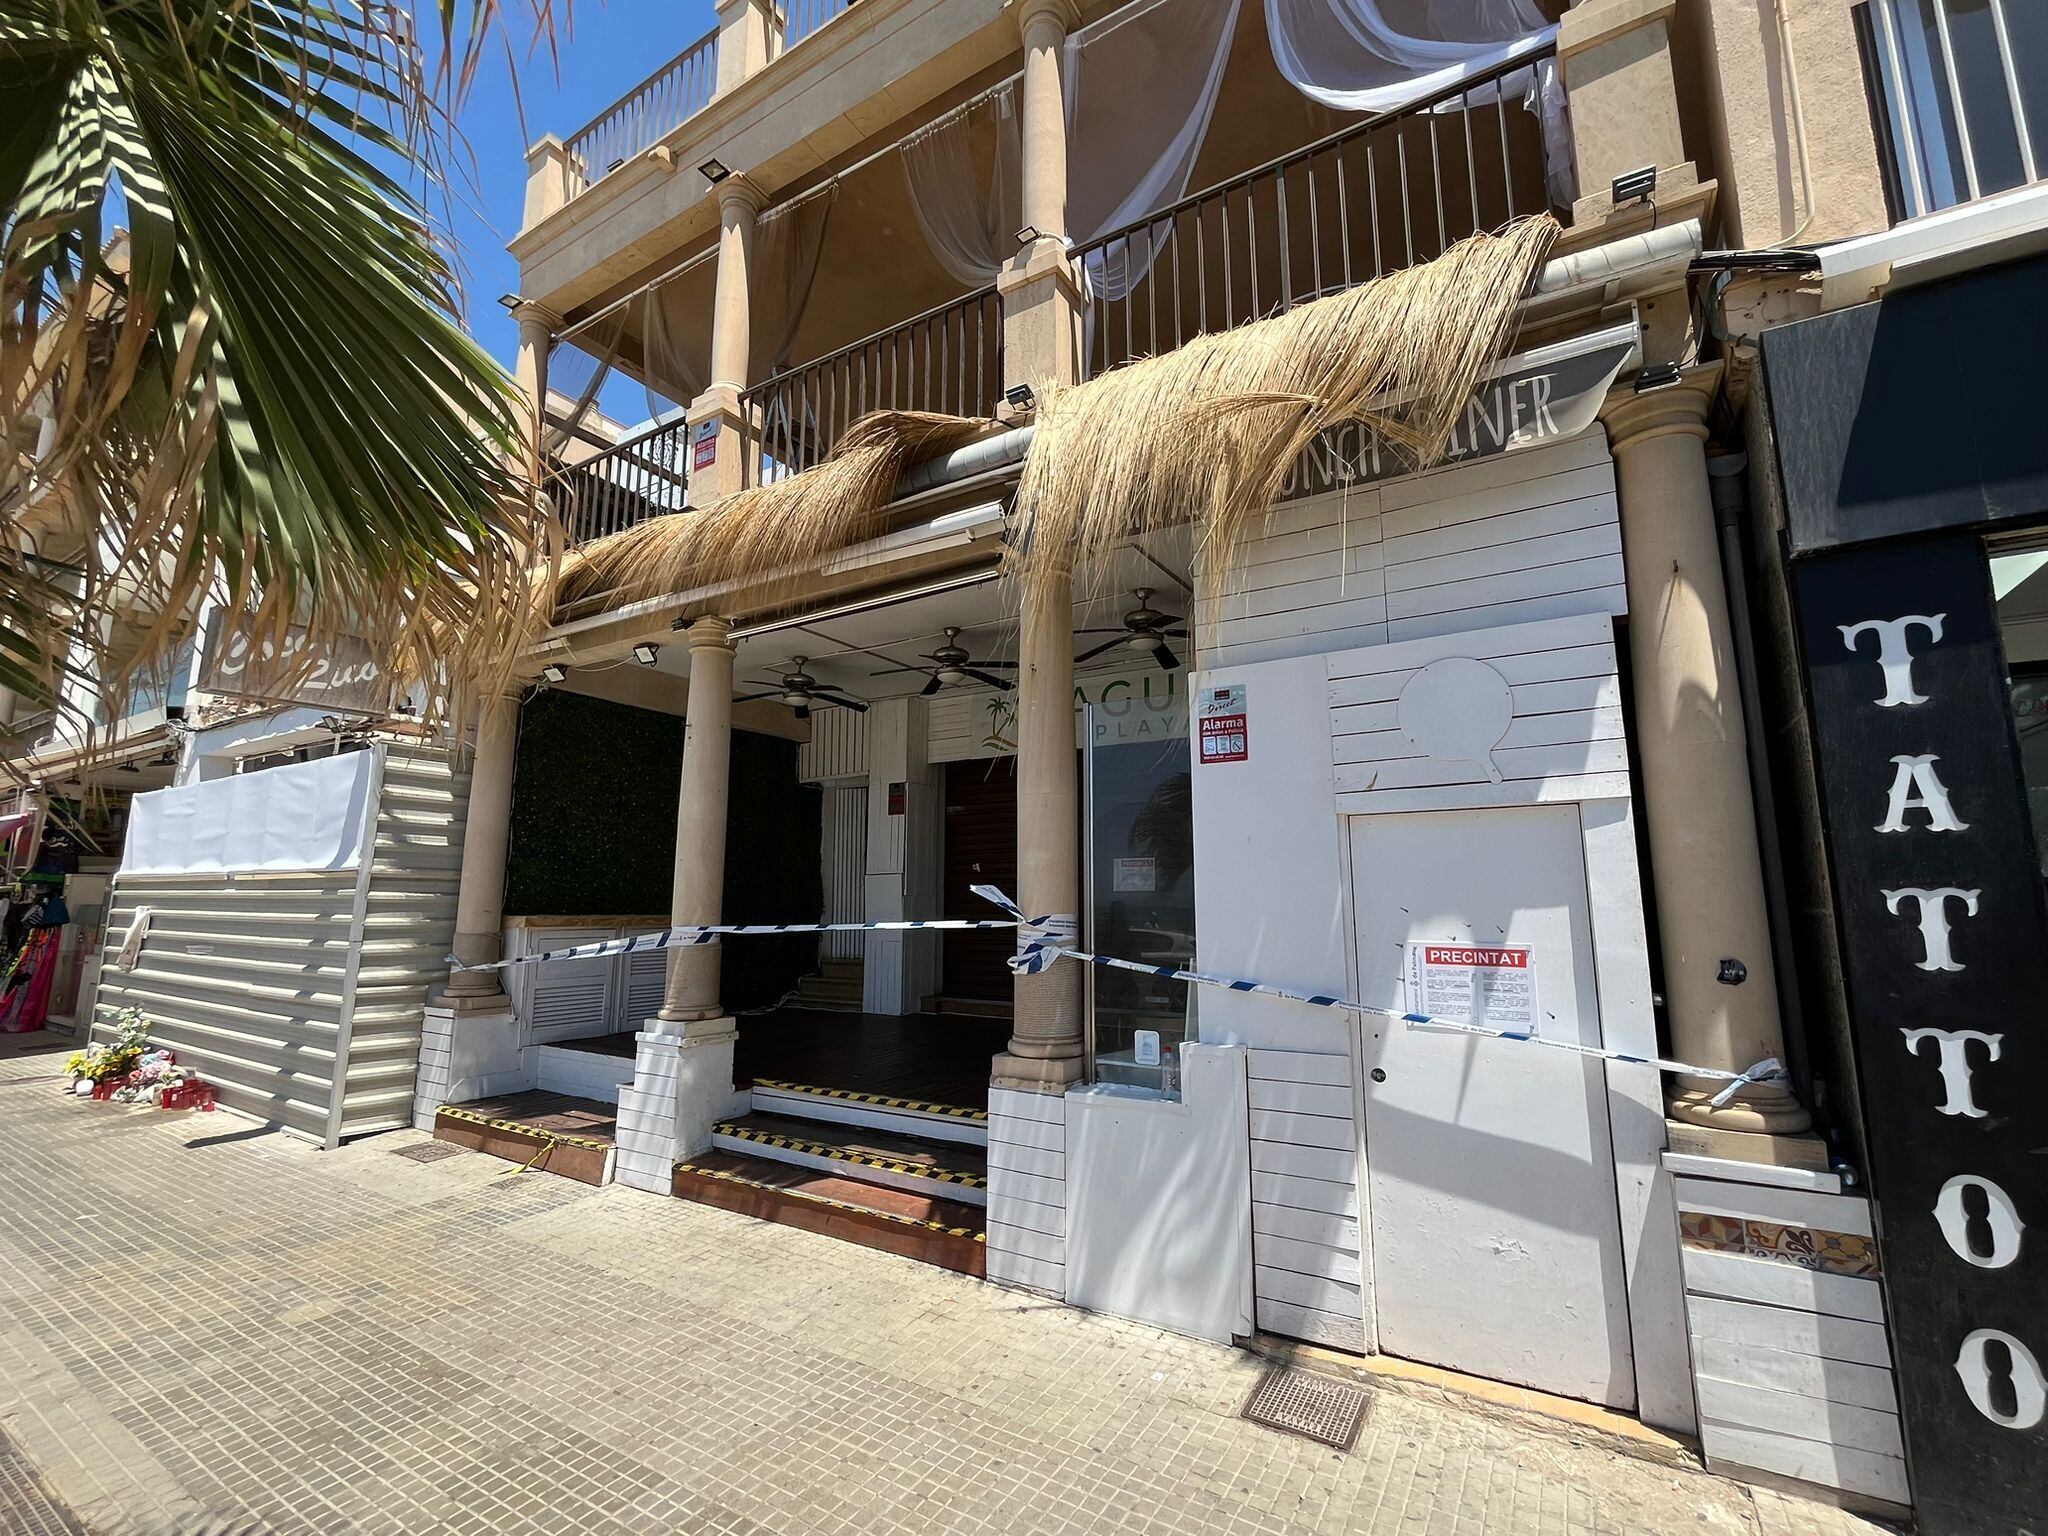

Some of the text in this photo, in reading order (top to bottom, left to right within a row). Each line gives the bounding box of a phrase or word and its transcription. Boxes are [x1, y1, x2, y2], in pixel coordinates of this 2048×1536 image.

[1202, 718, 1244, 731] Alarma
[1430, 950, 1522, 965] PRECINTAT
[1836, 613, 2048, 1430] TATTOO
